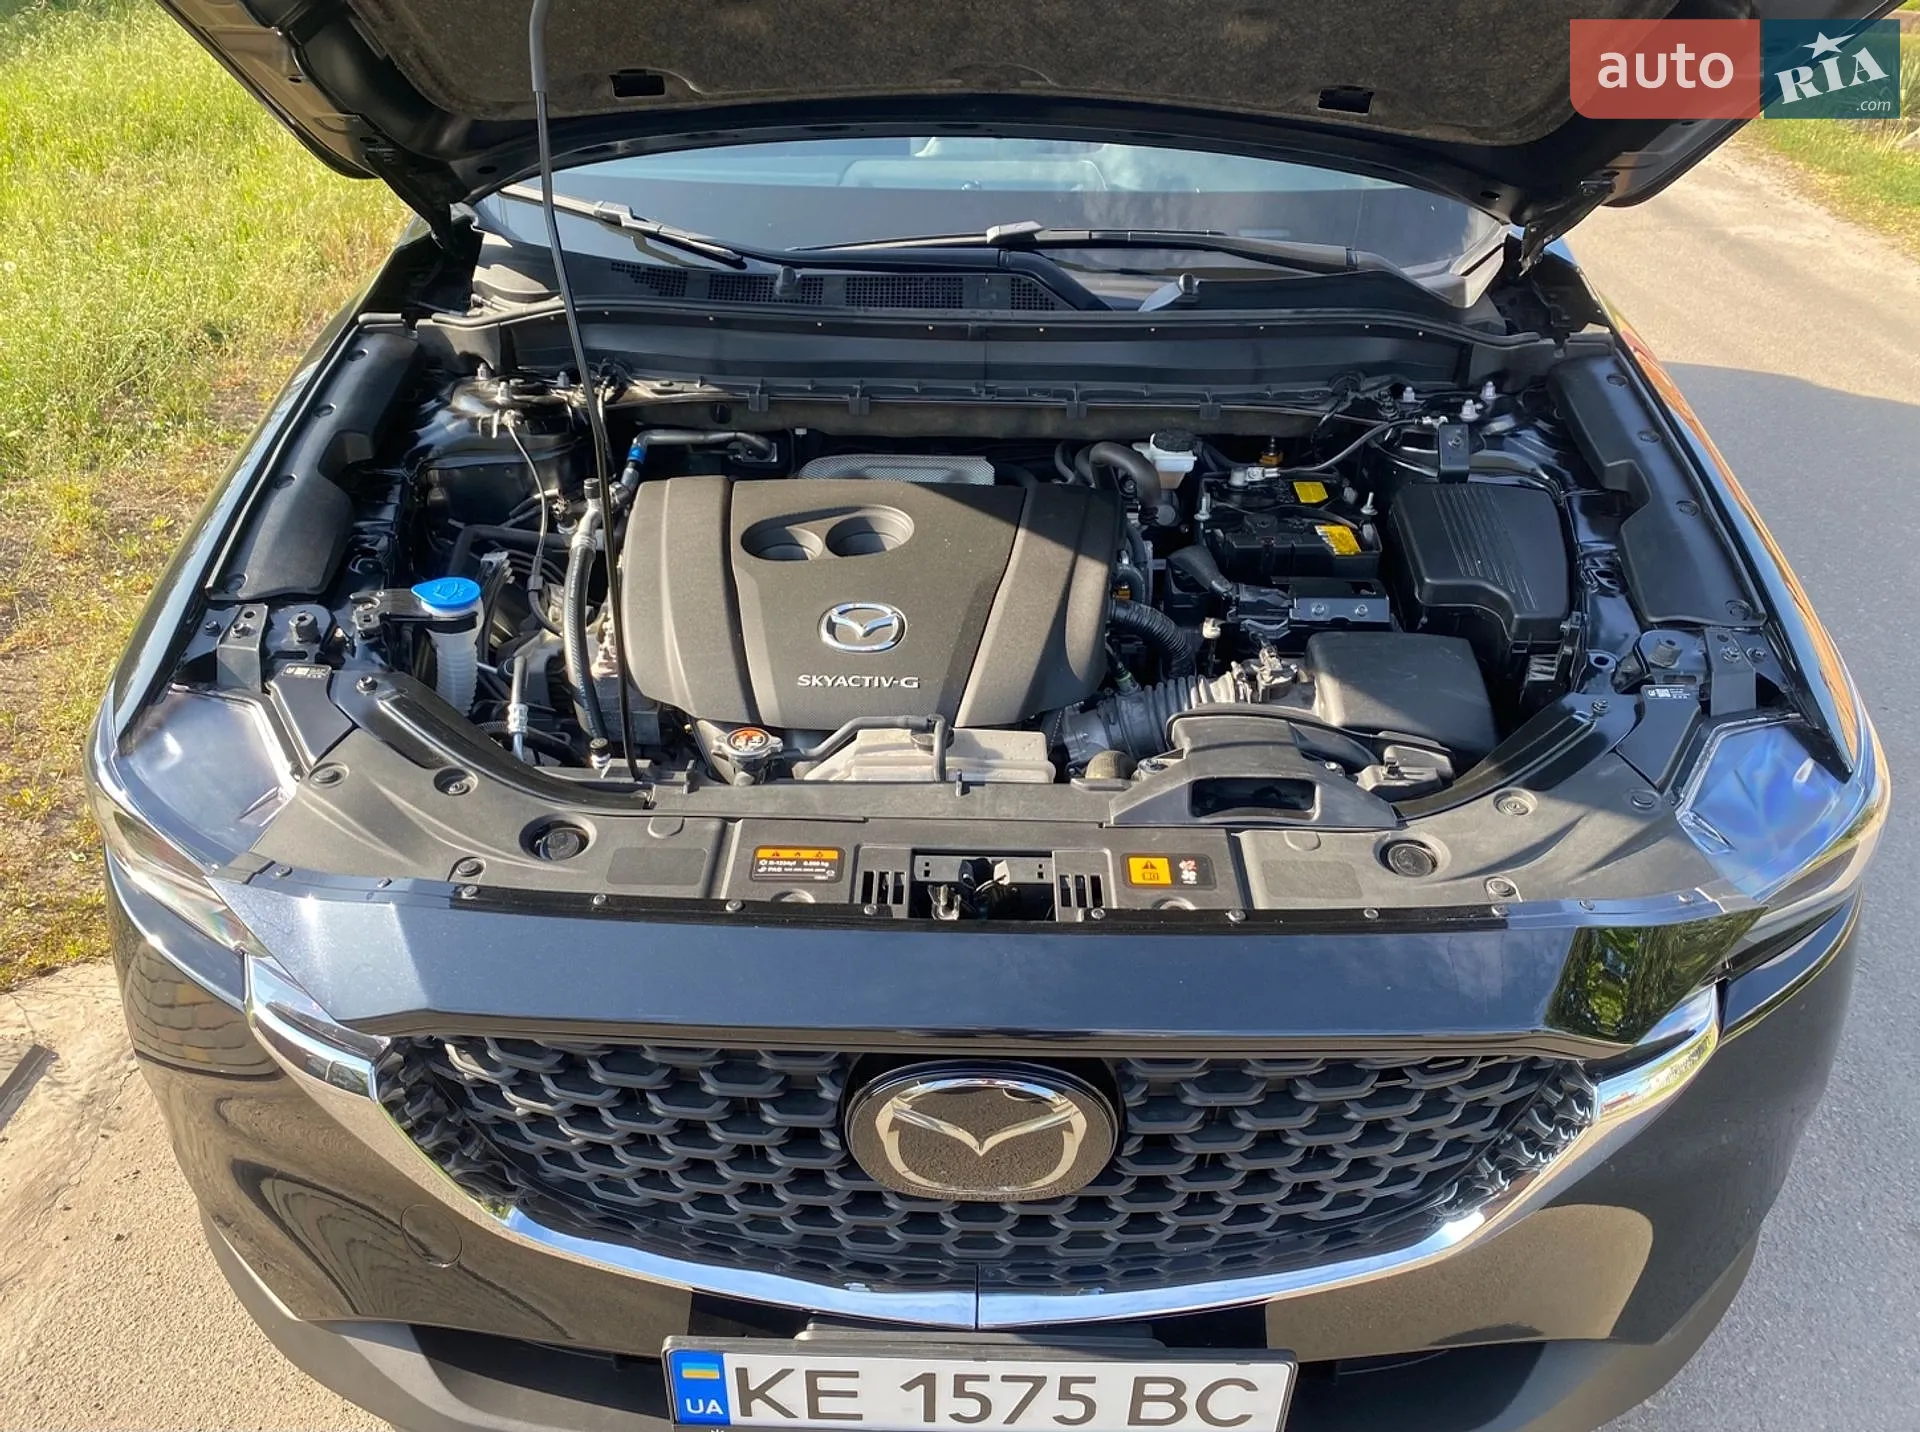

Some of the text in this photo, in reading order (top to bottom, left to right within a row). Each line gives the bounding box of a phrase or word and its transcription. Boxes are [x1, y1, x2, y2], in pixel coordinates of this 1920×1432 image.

[796, 674, 919, 688] SKYACTIV-G
[734, 1366, 1260, 1427] KE 1575 BC
[685, 1398, 724, 1415] UA
